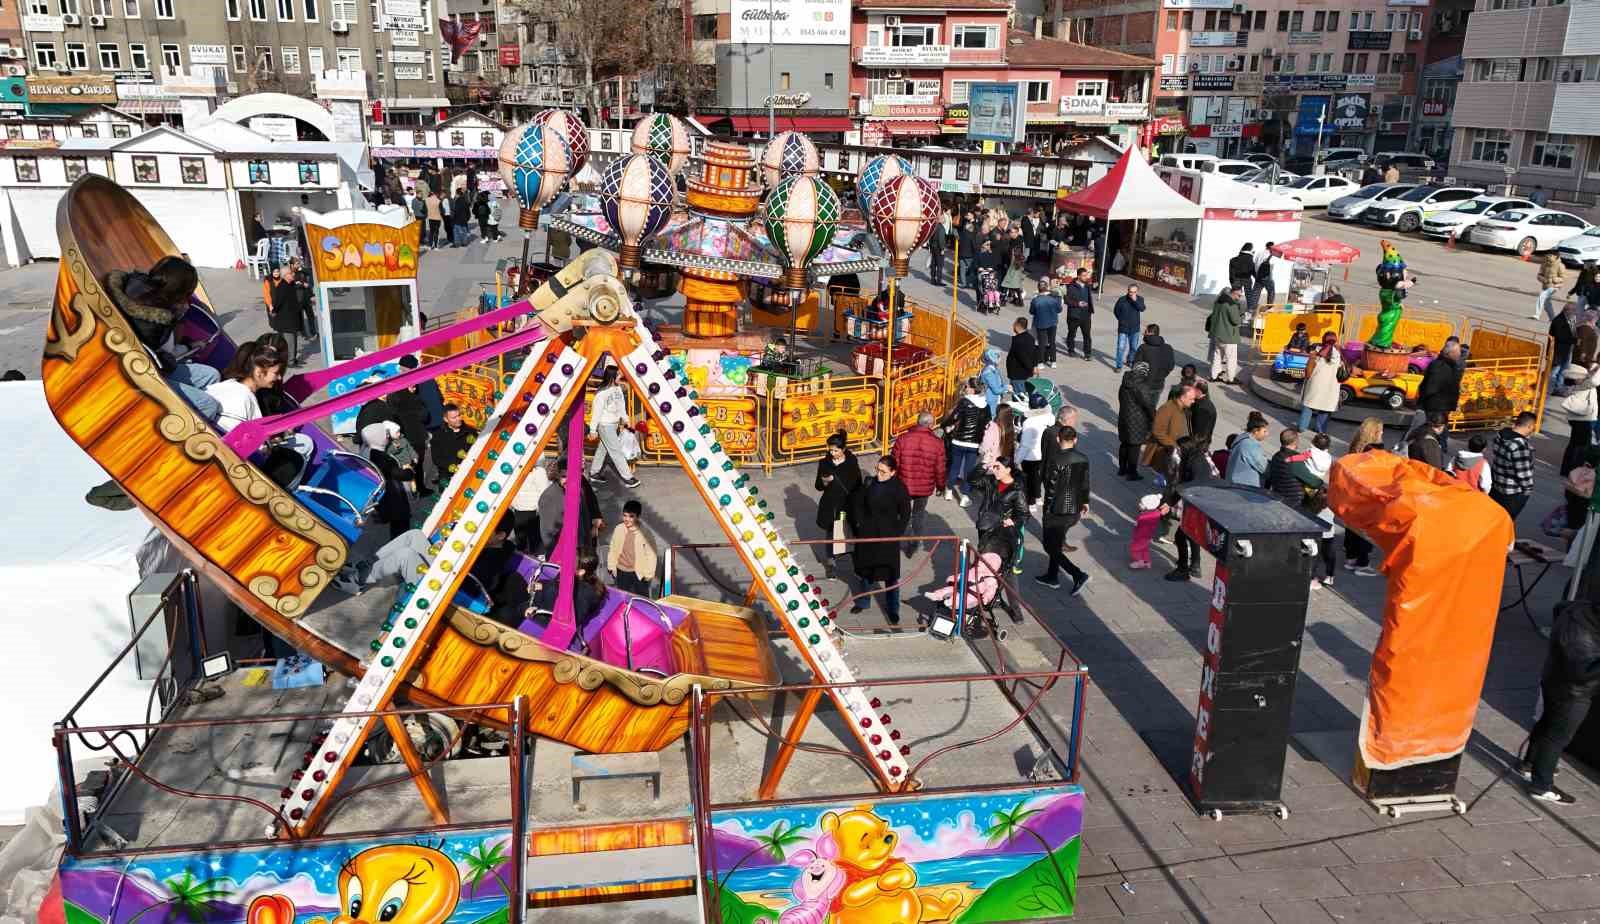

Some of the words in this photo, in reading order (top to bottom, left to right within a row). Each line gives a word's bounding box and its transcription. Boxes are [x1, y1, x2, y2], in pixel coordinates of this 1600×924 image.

[918, 81, 940, 89] AVUKAT
[1071, 98, 1099, 107] DNA
[321, 235, 416, 272] SAMBA
[791, 397, 868, 422] SAMBA
